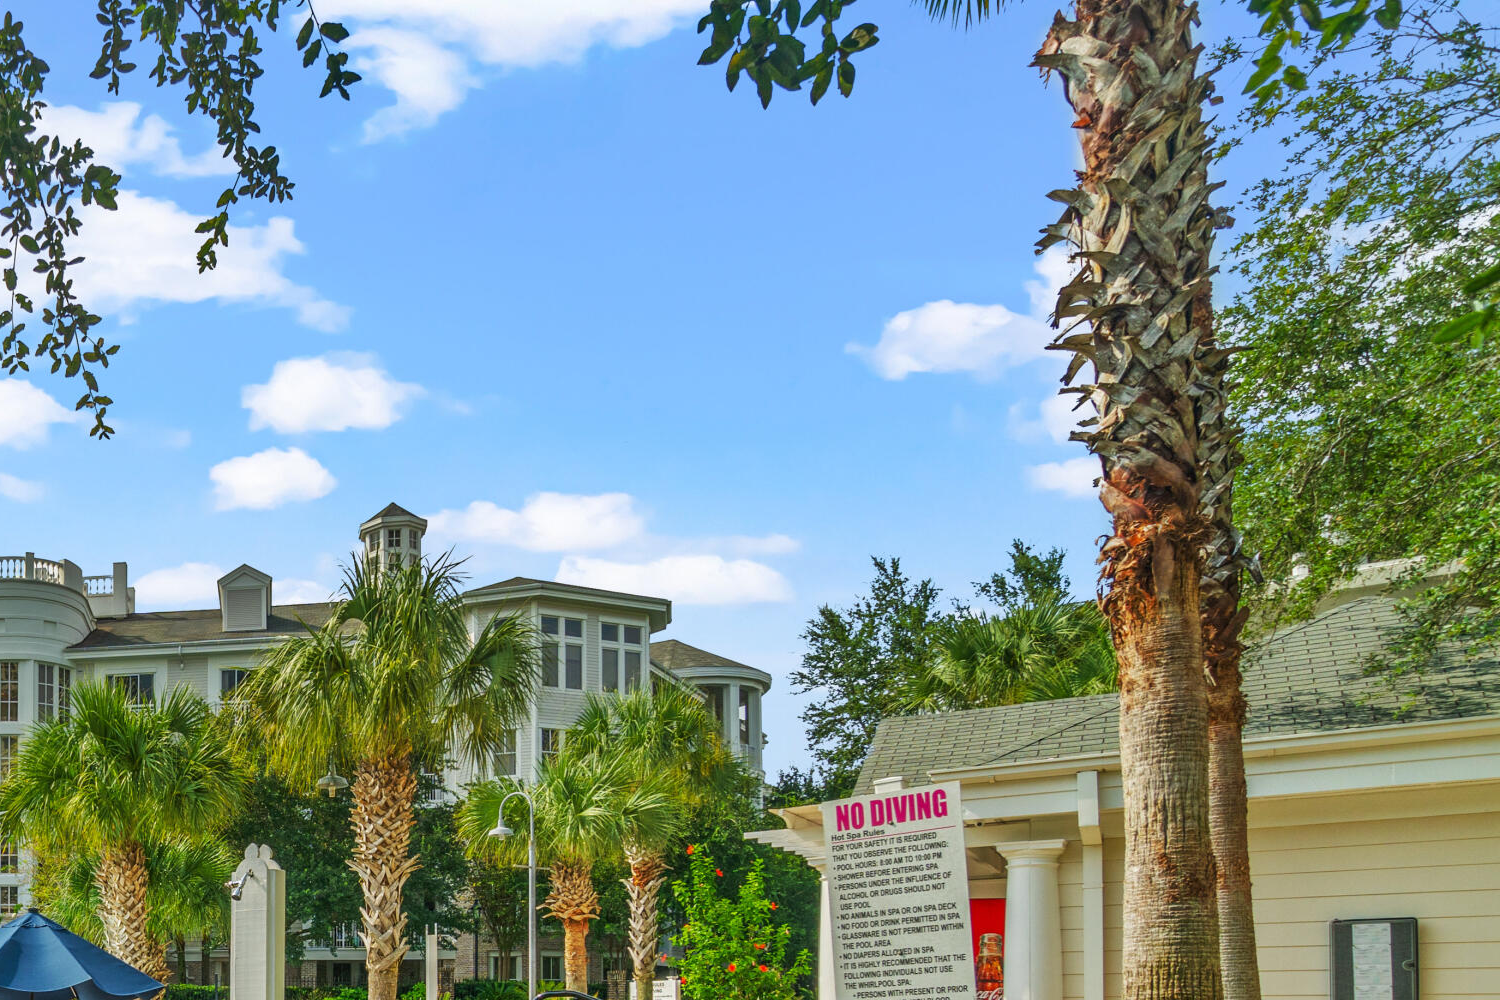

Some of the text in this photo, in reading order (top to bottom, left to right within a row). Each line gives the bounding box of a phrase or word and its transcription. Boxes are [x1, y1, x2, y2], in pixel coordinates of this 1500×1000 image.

[836, 789, 948, 832] NO DIVING
[831, 829, 885, 841] Hot Spa Rules
[832, 844, 844, 852] FOR
[845, 842, 863, 851] YOUR
[864, 839, 888, 849] SAFETY
[903, 832, 937, 843] REQUIRED
[833, 840, 949, 862] THAT YOU OBSERVE THE FOLLOWING:
[836, 851, 942, 872] POOL HOURS: 8:00 AM TO 10:00 PM
[837, 872, 864, 881] SHOWER
[865, 869, 890, 878] BEFORE
[892, 865, 924, 875] ENTERING
[838, 881, 867, 891] PERSONS
[868, 878, 890, 887] UNDER
[905, 872, 941, 883] INFLUENCE
[942, 871, 952, 879] OF
[840, 891, 869, 901] ALCOHOL
[880, 888, 903, 896] DRUGS
[904, 884, 930, 893] SHOULD
[931, 882, 945, 890] NOT
[840, 901, 871, 911] USE POOL
[850, 910, 879, 920] ANIMALS
[887, 907, 900, 915] SPA
[901, 906, 912, 914] OR
[912, 905, 922, 913] ON
[938, 902, 957, 910] DECK
[841, 922, 850, 930] NO
[851, 921, 869, 929] FOOD
[870, 920, 879, 928] OR
[880, 918, 900, 926] DRINK
[901, 914, 938, 924] PERMITTED
[947, 912, 960, 920] SPA
[841, 922, 964, 940] GLASSWARE IS NOT PERMITTED WITHIN
[842, 942, 855, 950] THE
[855, 941, 873, 949] POOL
[843, 952, 853, 960] NO
[853, 950, 880, 959] DIAPERS
[921, 946, 935, 954] SPA
[858, 961, 880, 969] HIGHLY
[882, 956, 933, 967] RECOMMENDED
[934, 955, 951, 963] THAT
[844, 965, 953, 980] FOLLOWING INDIVIDUALS NOT USE
[845, 982, 857, 990] THE
[858, 980, 896, 989] WHIRLPOOL
[856, 985, 968, 999] PERSONS WITH PRESENT OR PRIOR
